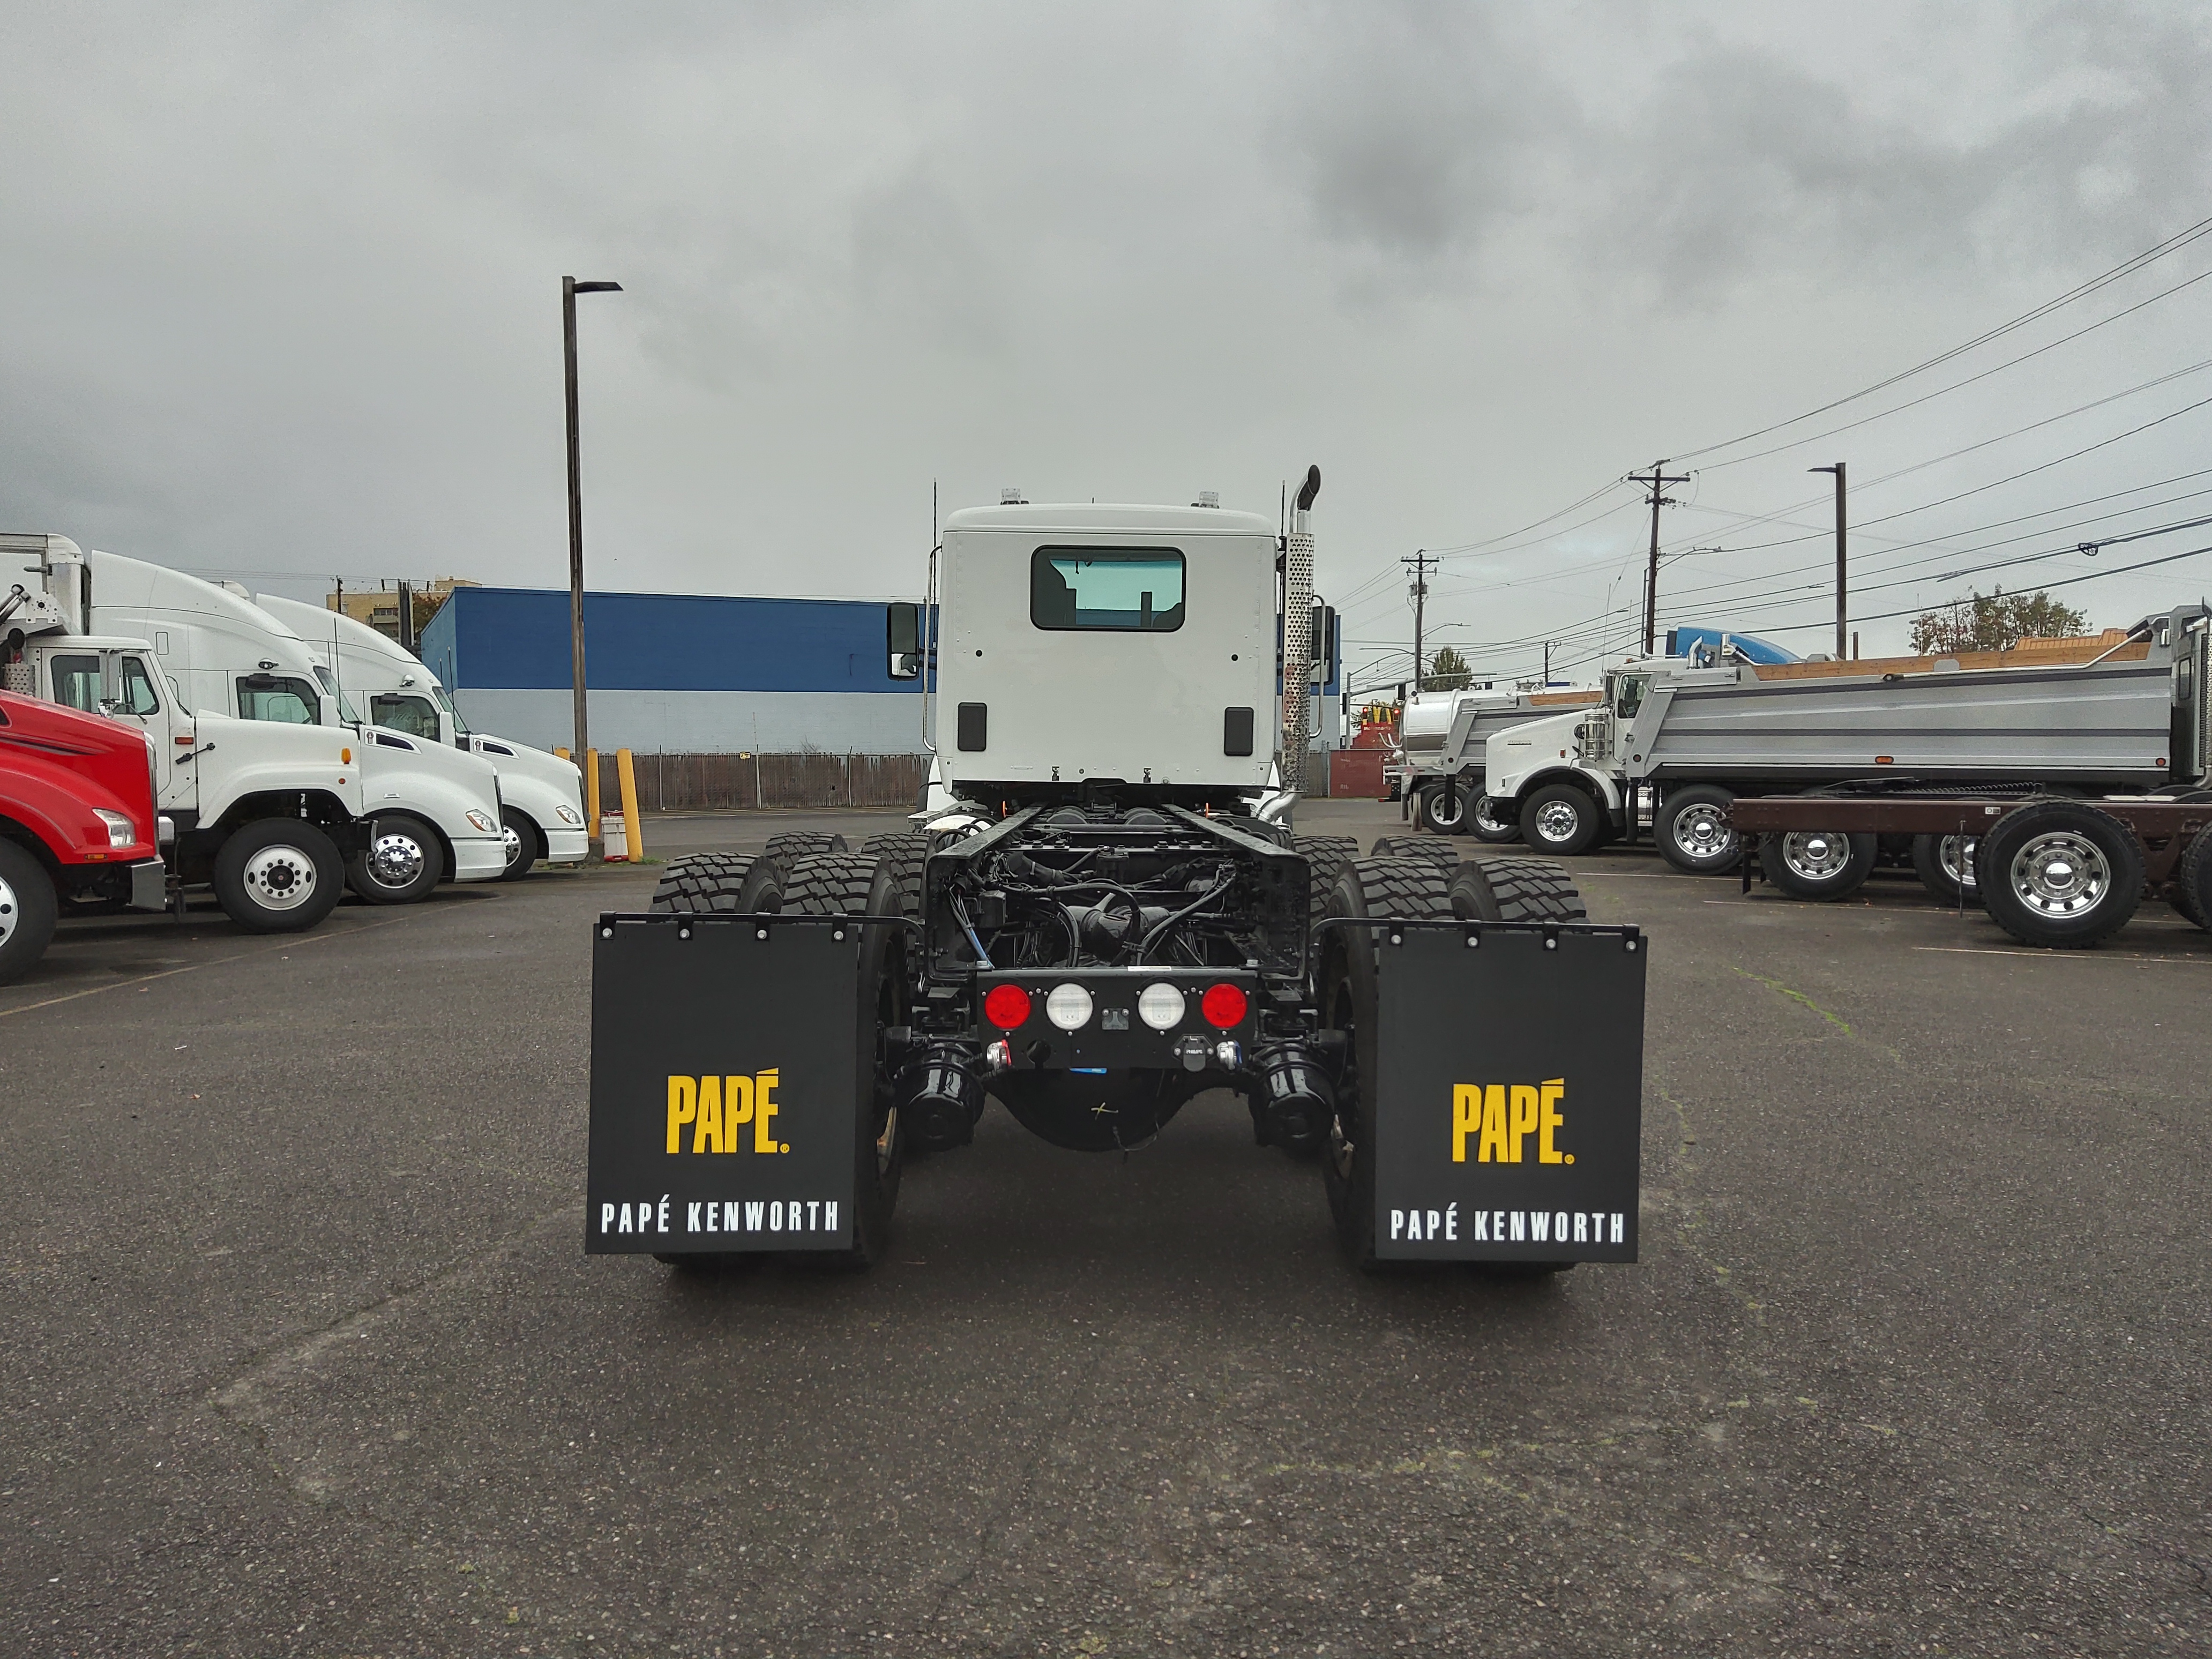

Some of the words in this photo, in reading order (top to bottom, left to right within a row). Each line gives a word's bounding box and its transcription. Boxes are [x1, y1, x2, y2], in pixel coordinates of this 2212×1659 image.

[601, 1194, 669, 1233] PAPÉ
[687, 1201, 838, 1232] KENWORTH
[1391, 1202, 1457, 1240] PAPÉ
[1475, 1211, 1624, 1243] KENWORTH
